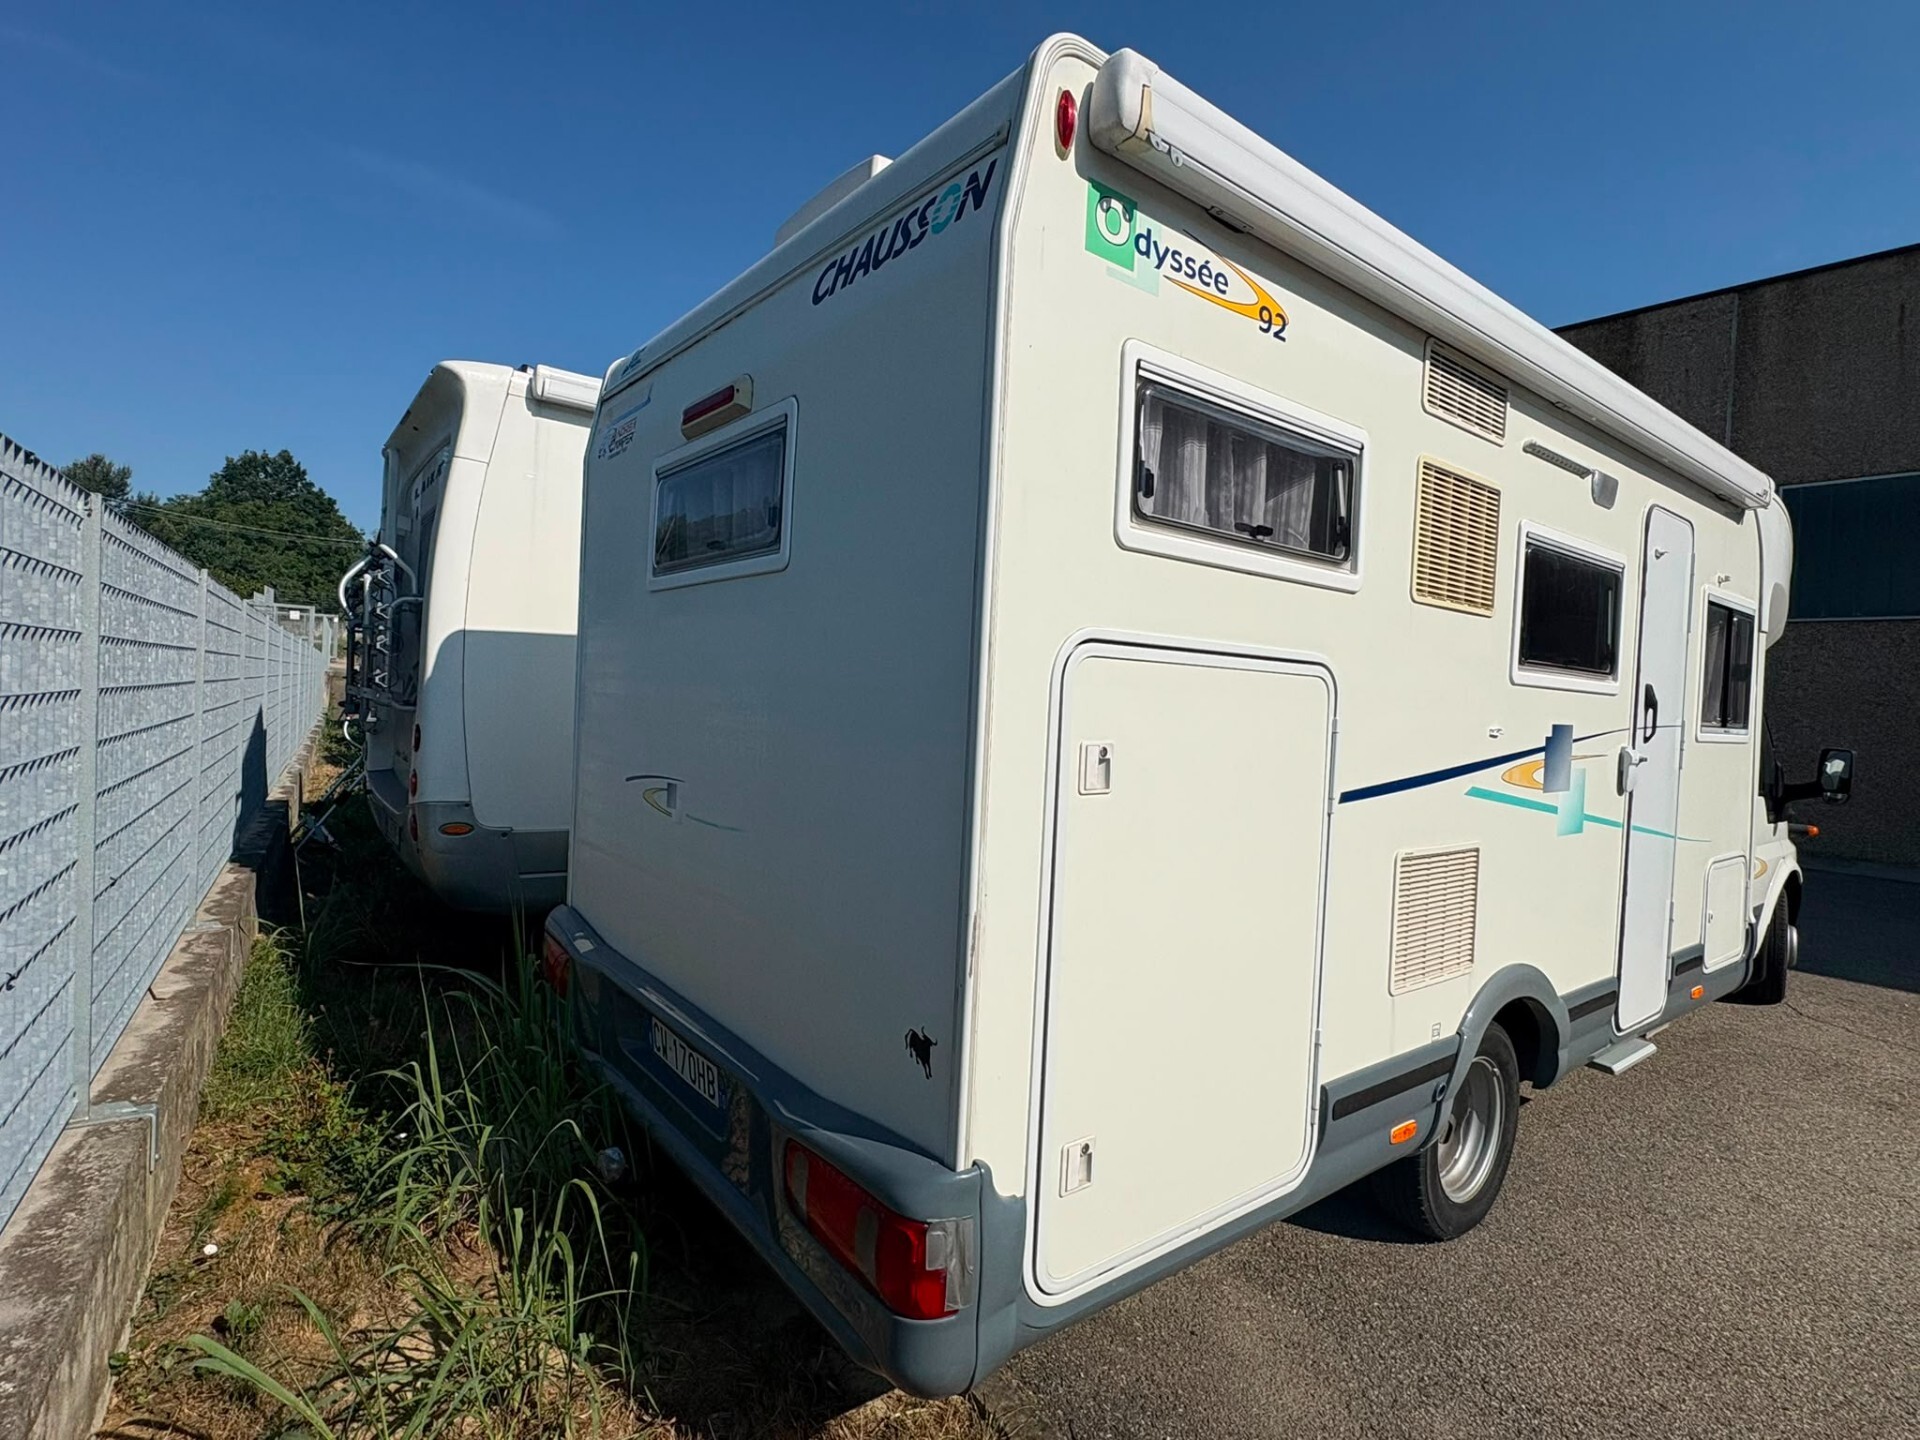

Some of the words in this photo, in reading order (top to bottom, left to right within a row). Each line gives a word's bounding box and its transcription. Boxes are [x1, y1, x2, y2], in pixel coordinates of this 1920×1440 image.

[812, 158, 998, 306] CHAUSSON
[1095, 196, 1229, 295] Odyssée
[1258, 305, 1287, 342] 92
